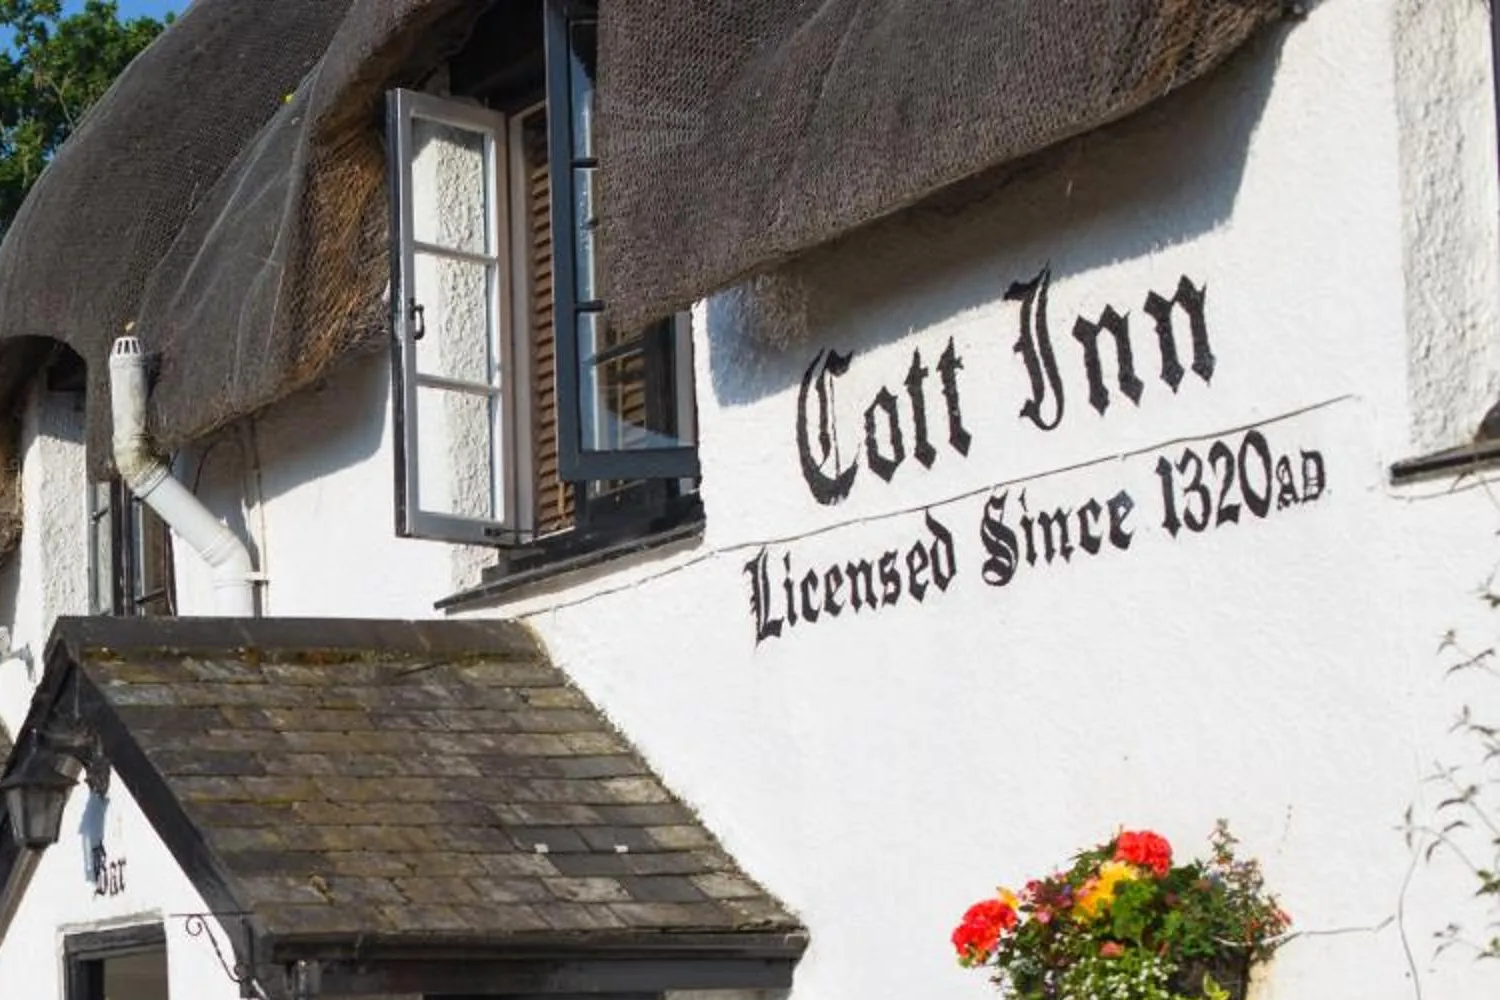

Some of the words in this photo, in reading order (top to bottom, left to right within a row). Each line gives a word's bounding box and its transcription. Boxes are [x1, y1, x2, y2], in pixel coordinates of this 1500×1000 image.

[796, 337, 972, 506] Cott
[1004, 260, 1216, 431] Inn
[743, 507, 957, 647] Licensed
[980, 487, 1135, 587] Since
[92, 841, 127, 899] Bar
